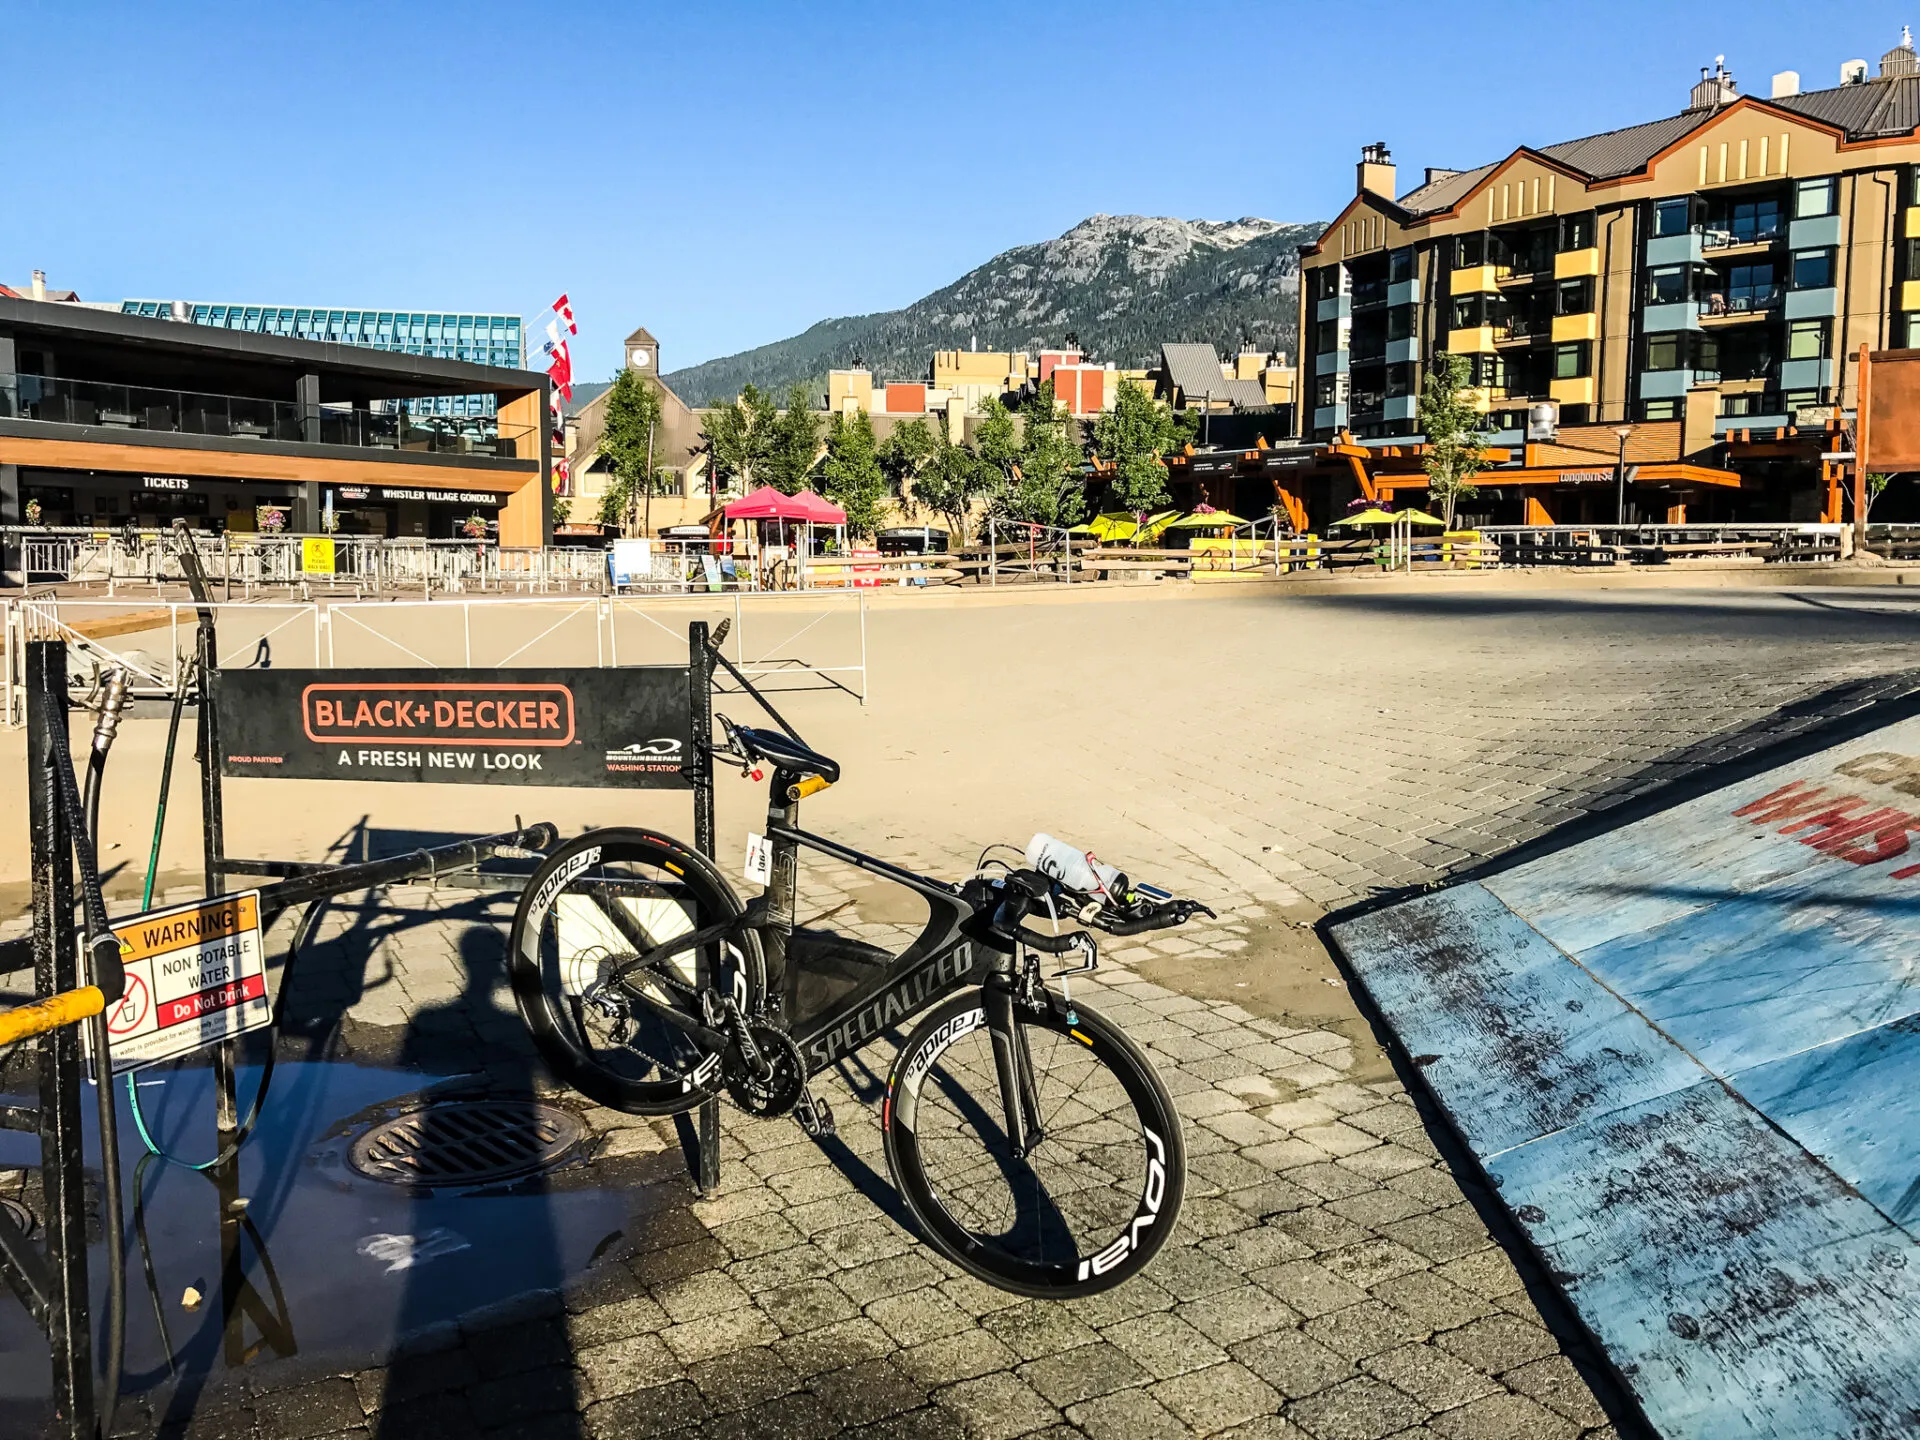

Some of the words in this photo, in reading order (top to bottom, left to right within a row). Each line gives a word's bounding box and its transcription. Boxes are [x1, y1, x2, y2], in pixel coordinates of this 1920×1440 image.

[143, 477, 189, 489] TICKETS
[1560, 471, 1600, 485] Longhorn
[382, 489, 425, 500] WHISTLER
[426, 491, 459, 502] VILLAGE
[460, 492, 497, 503] GONDOLA
[315, 699, 561, 730] BLACK+DECKER
[228, 755, 251, 763] PROUD
[252, 756, 283, 764] PARTNER
[337, 750, 352, 766] A
[358, 750, 423, 768] FRESH
[428, 752, 476, 769] NEW
[483, 753, 542, 770] LOOK
[606, 764, 645, 772] WASHING
[647, 764, 682, 773] STATION
[1731, 780, 1920, 880] WHIS
[536, 853, 590, 910] rapide
[143, 909, 234, 949] WARNING
[162, 957, 192, 977] NON
[196, 940, 251, 967] POTABLE
[188, 966, 231, 989] WATER
[173, 1004, 191, 1019] Do
[194, 995, 216, 1013] Not
[218, 984, 250, 1004] Drink
[682, 942, 747, 1093] roal
[809, 942, 972, 1069] SPECIALIZED
[120, 1047, 136, 1056] water
[144, 1035, 169, 1048] provided
[178, 1025, 200, 1036] washing
[914, 1011, 977, 1073] rapide
[1077, 1126, 1166, 1281] roval
